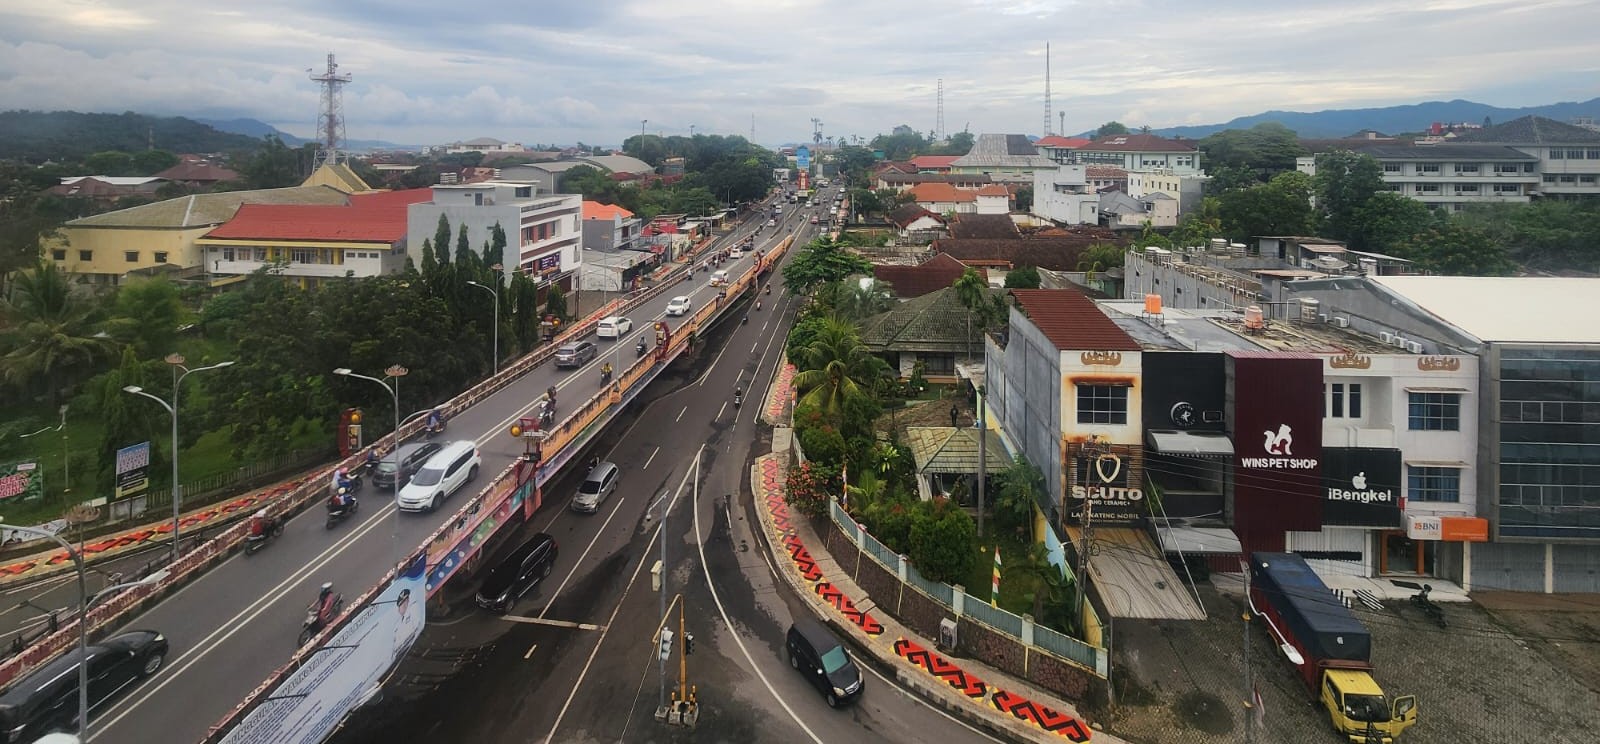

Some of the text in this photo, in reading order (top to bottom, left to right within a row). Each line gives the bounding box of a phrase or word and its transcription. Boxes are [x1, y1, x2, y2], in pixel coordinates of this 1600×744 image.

[1241, 457, 1318, 469] WINS PET SHOP
[1071, 485, 1143, 500] SCUTO
[1328, 487, 1391, 503] iBengkel
[1422, 522, 1439, 531] BNI
